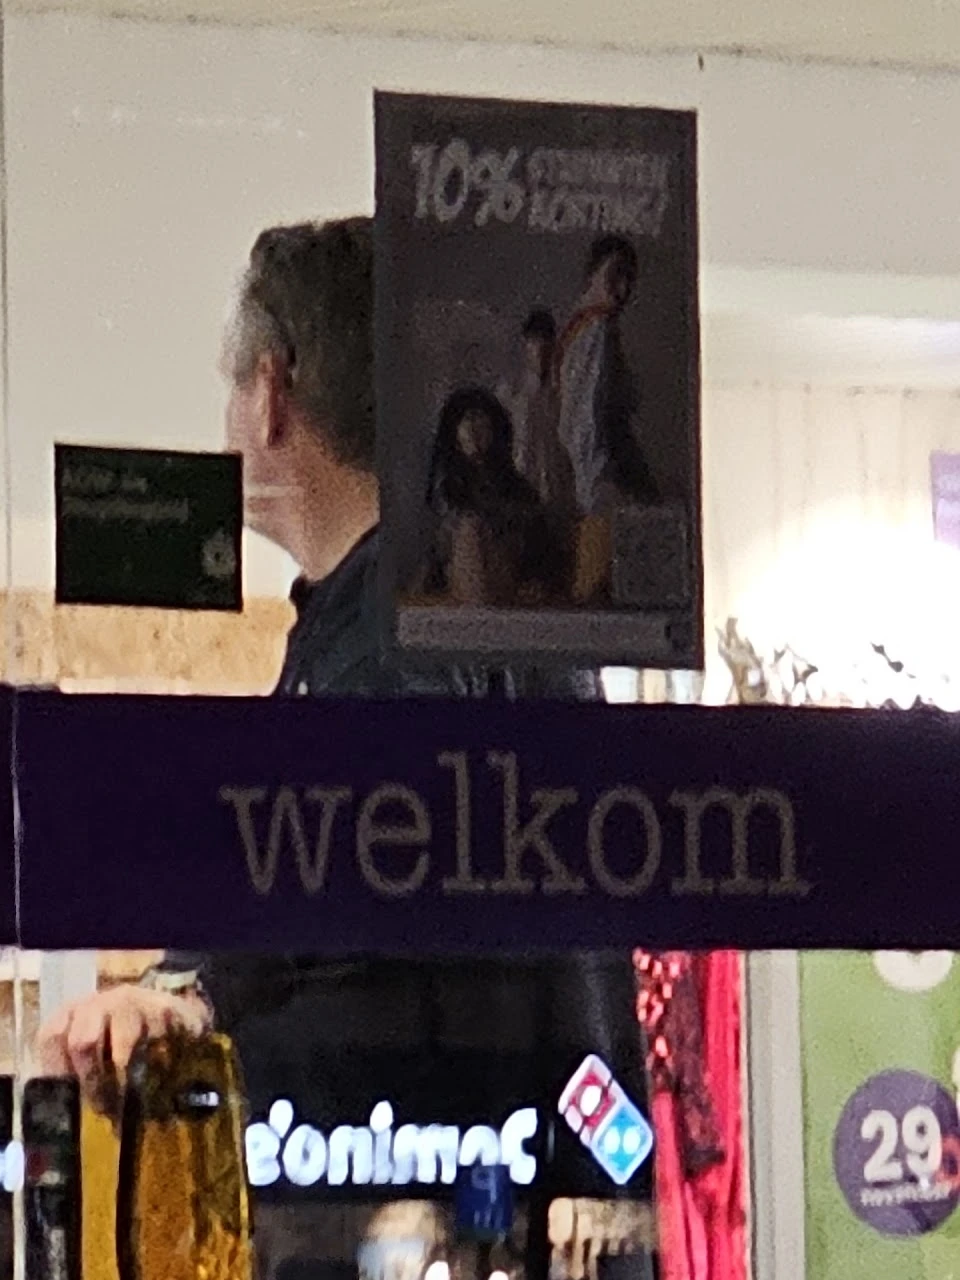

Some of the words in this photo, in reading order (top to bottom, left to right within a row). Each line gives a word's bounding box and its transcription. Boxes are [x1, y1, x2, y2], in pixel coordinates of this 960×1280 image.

[410, 138, 526, 227] 10%
[216, 749, 814, 898] welkom
[860, 1104, 943, 1183] 29
